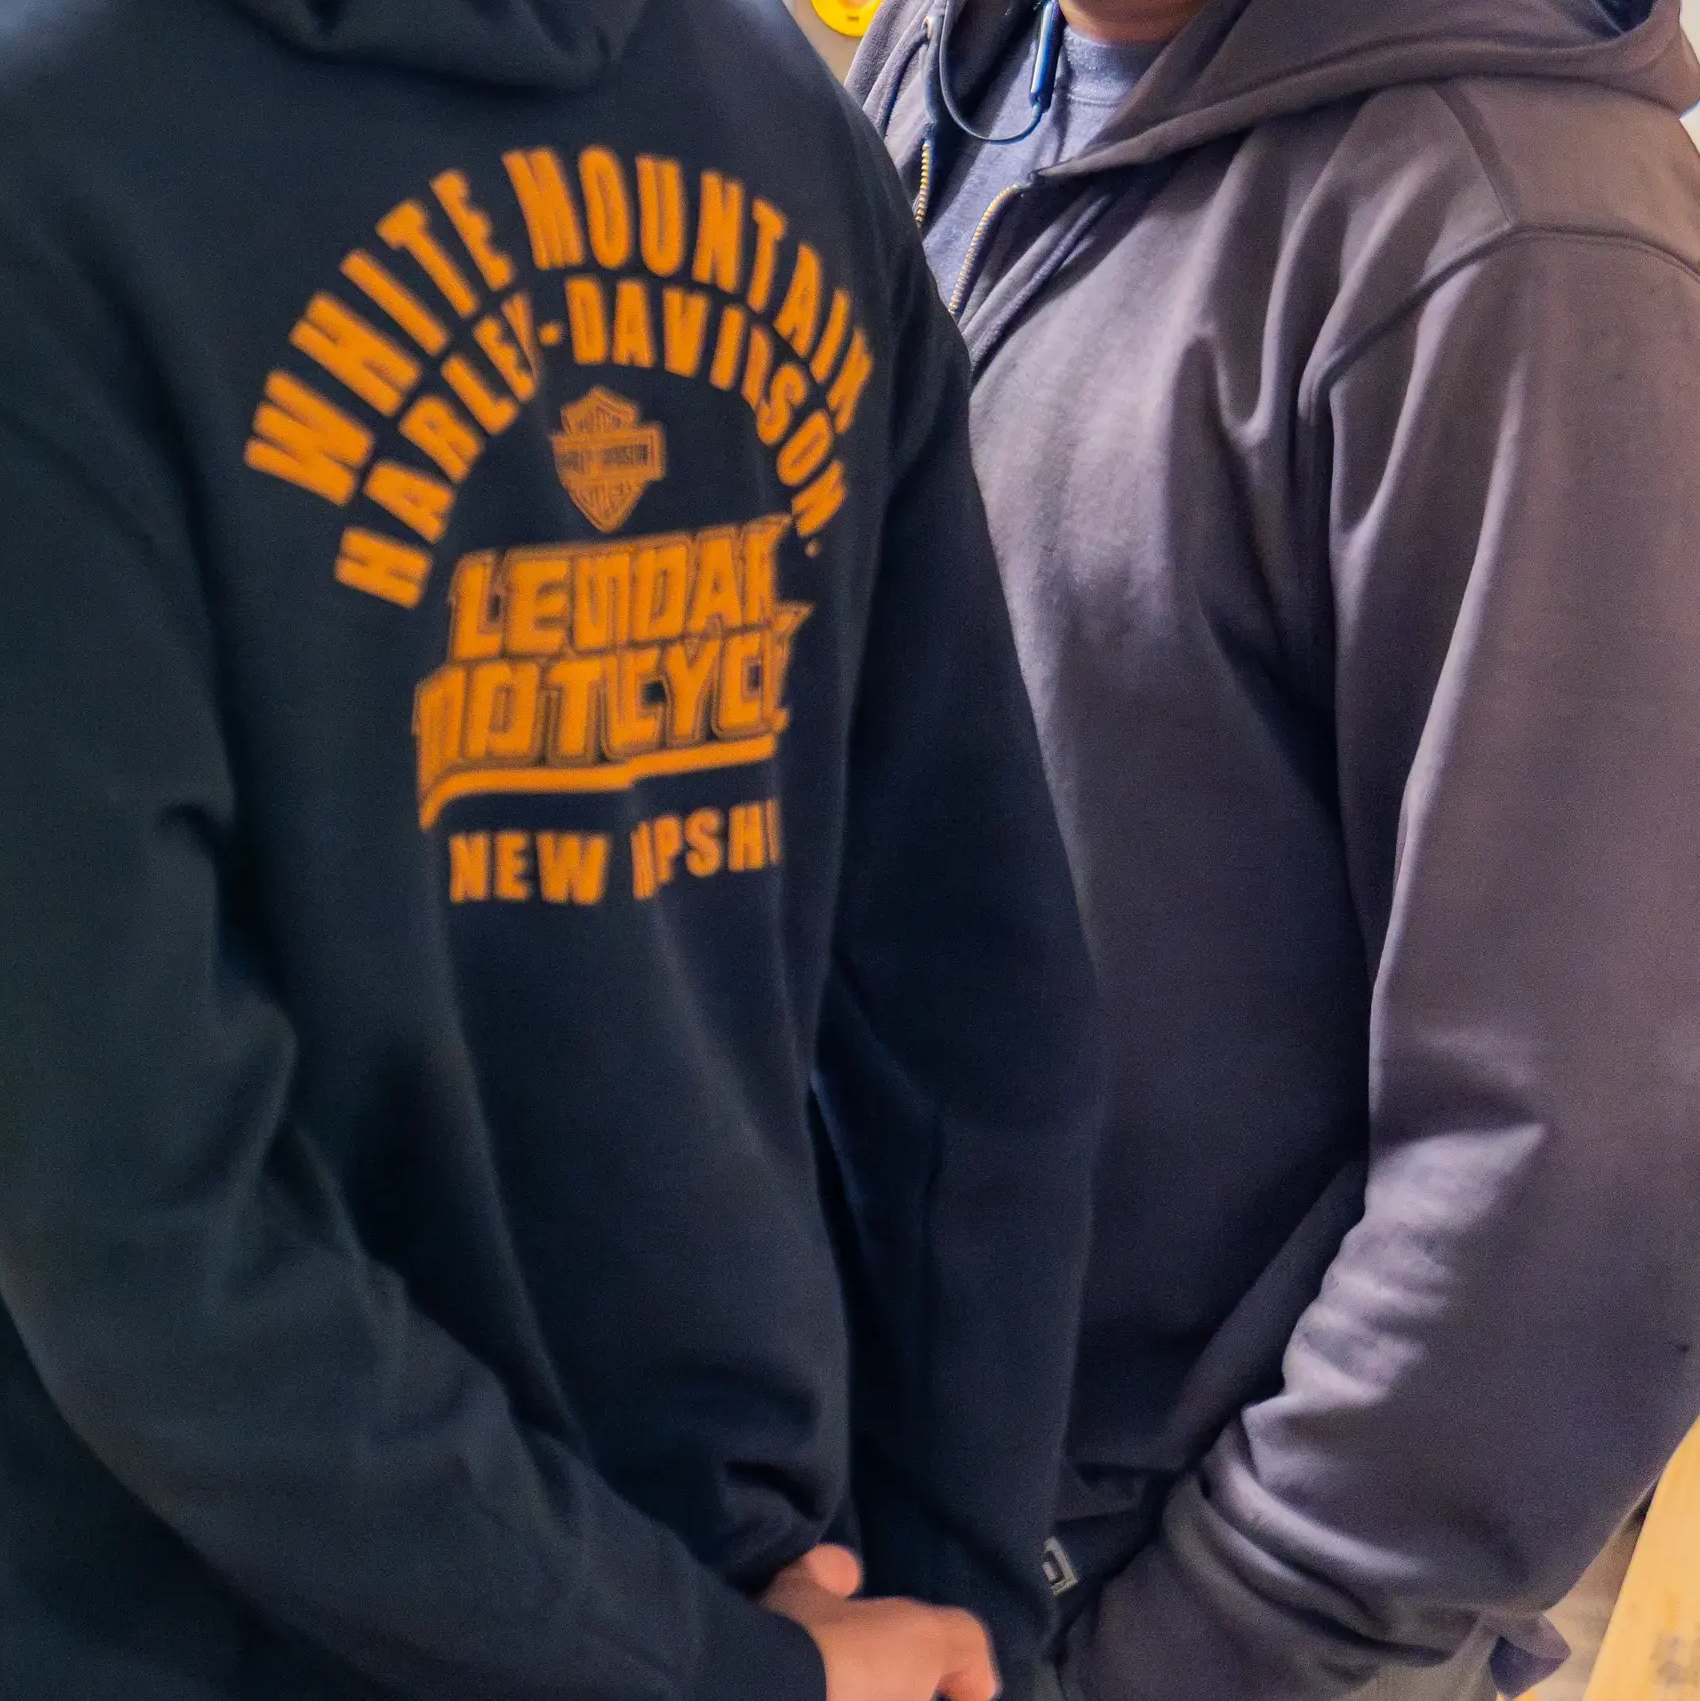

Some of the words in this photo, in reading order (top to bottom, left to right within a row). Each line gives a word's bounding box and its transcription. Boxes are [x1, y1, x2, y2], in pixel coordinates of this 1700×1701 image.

[244, 167, 521, 508] WHITE
[502, 144, 875, 437] MOUNTAIN
[449, 831, 611, 905] NEW
